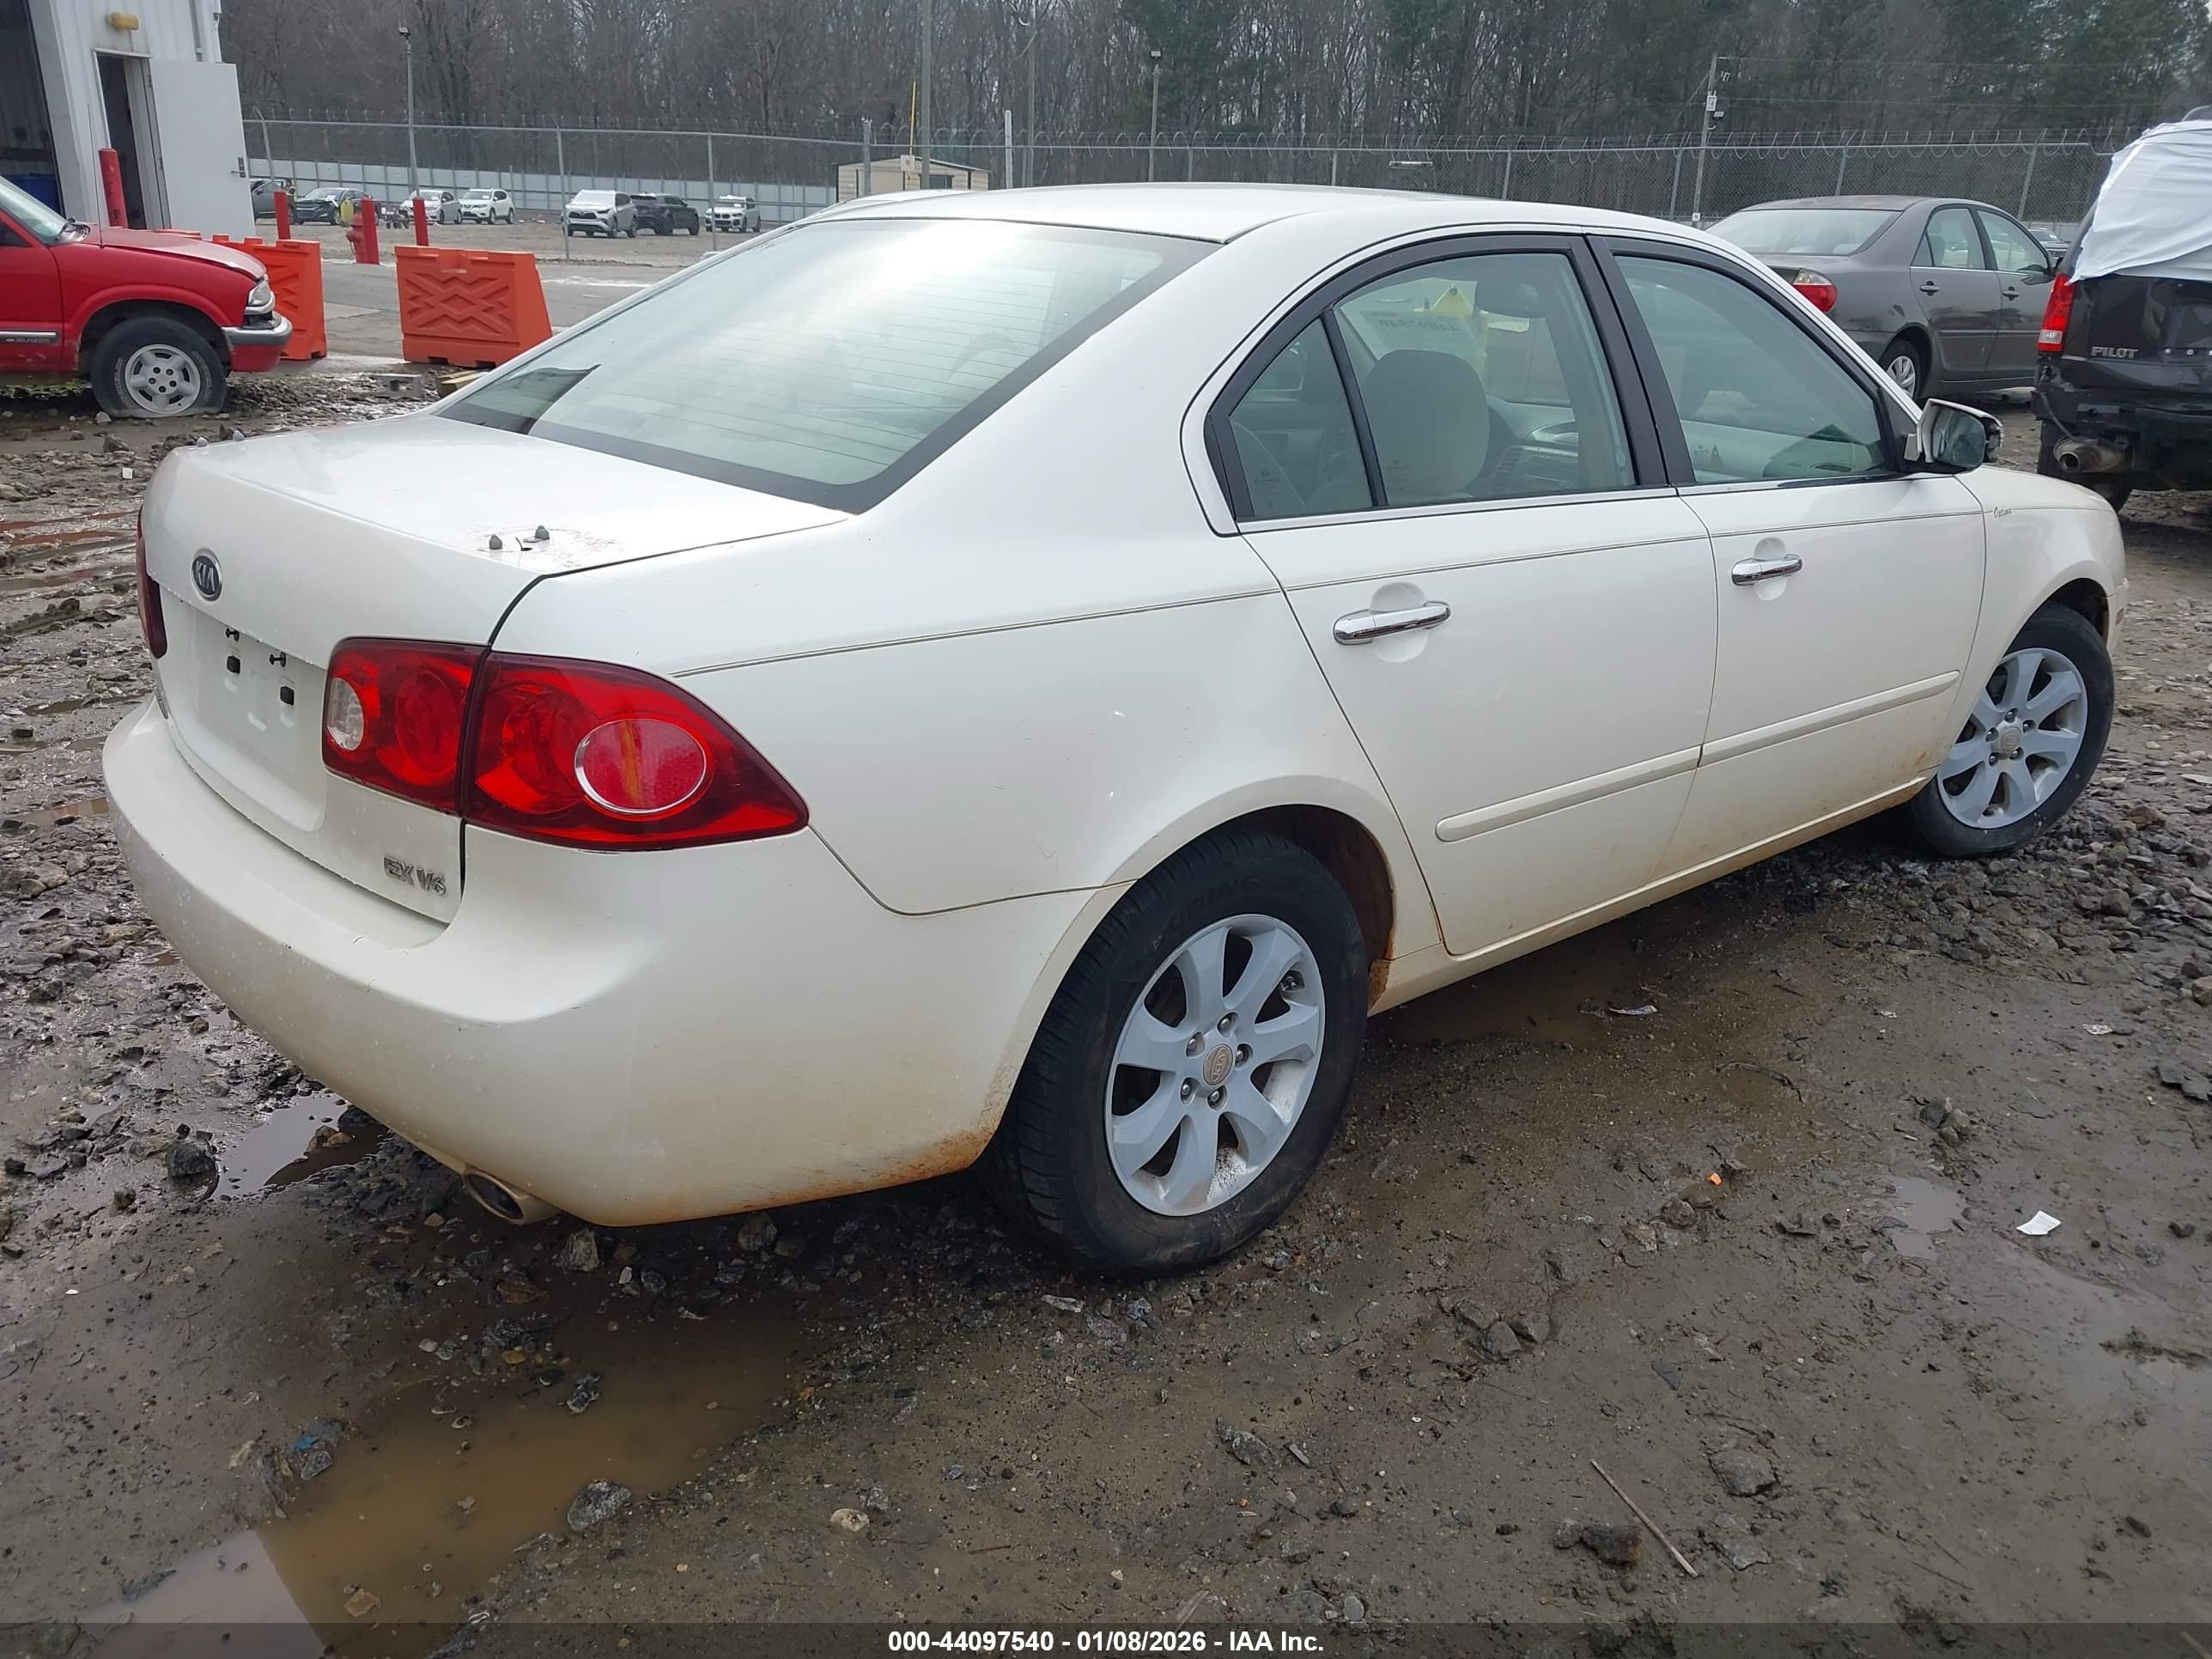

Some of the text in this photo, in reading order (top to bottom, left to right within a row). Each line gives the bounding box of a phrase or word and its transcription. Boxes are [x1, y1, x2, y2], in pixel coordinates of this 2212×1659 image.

[2091, 346, 2139, 359] PILOT
[195, 560, 216, 592] KIA
[383, 854, 447, 896] EX V6
